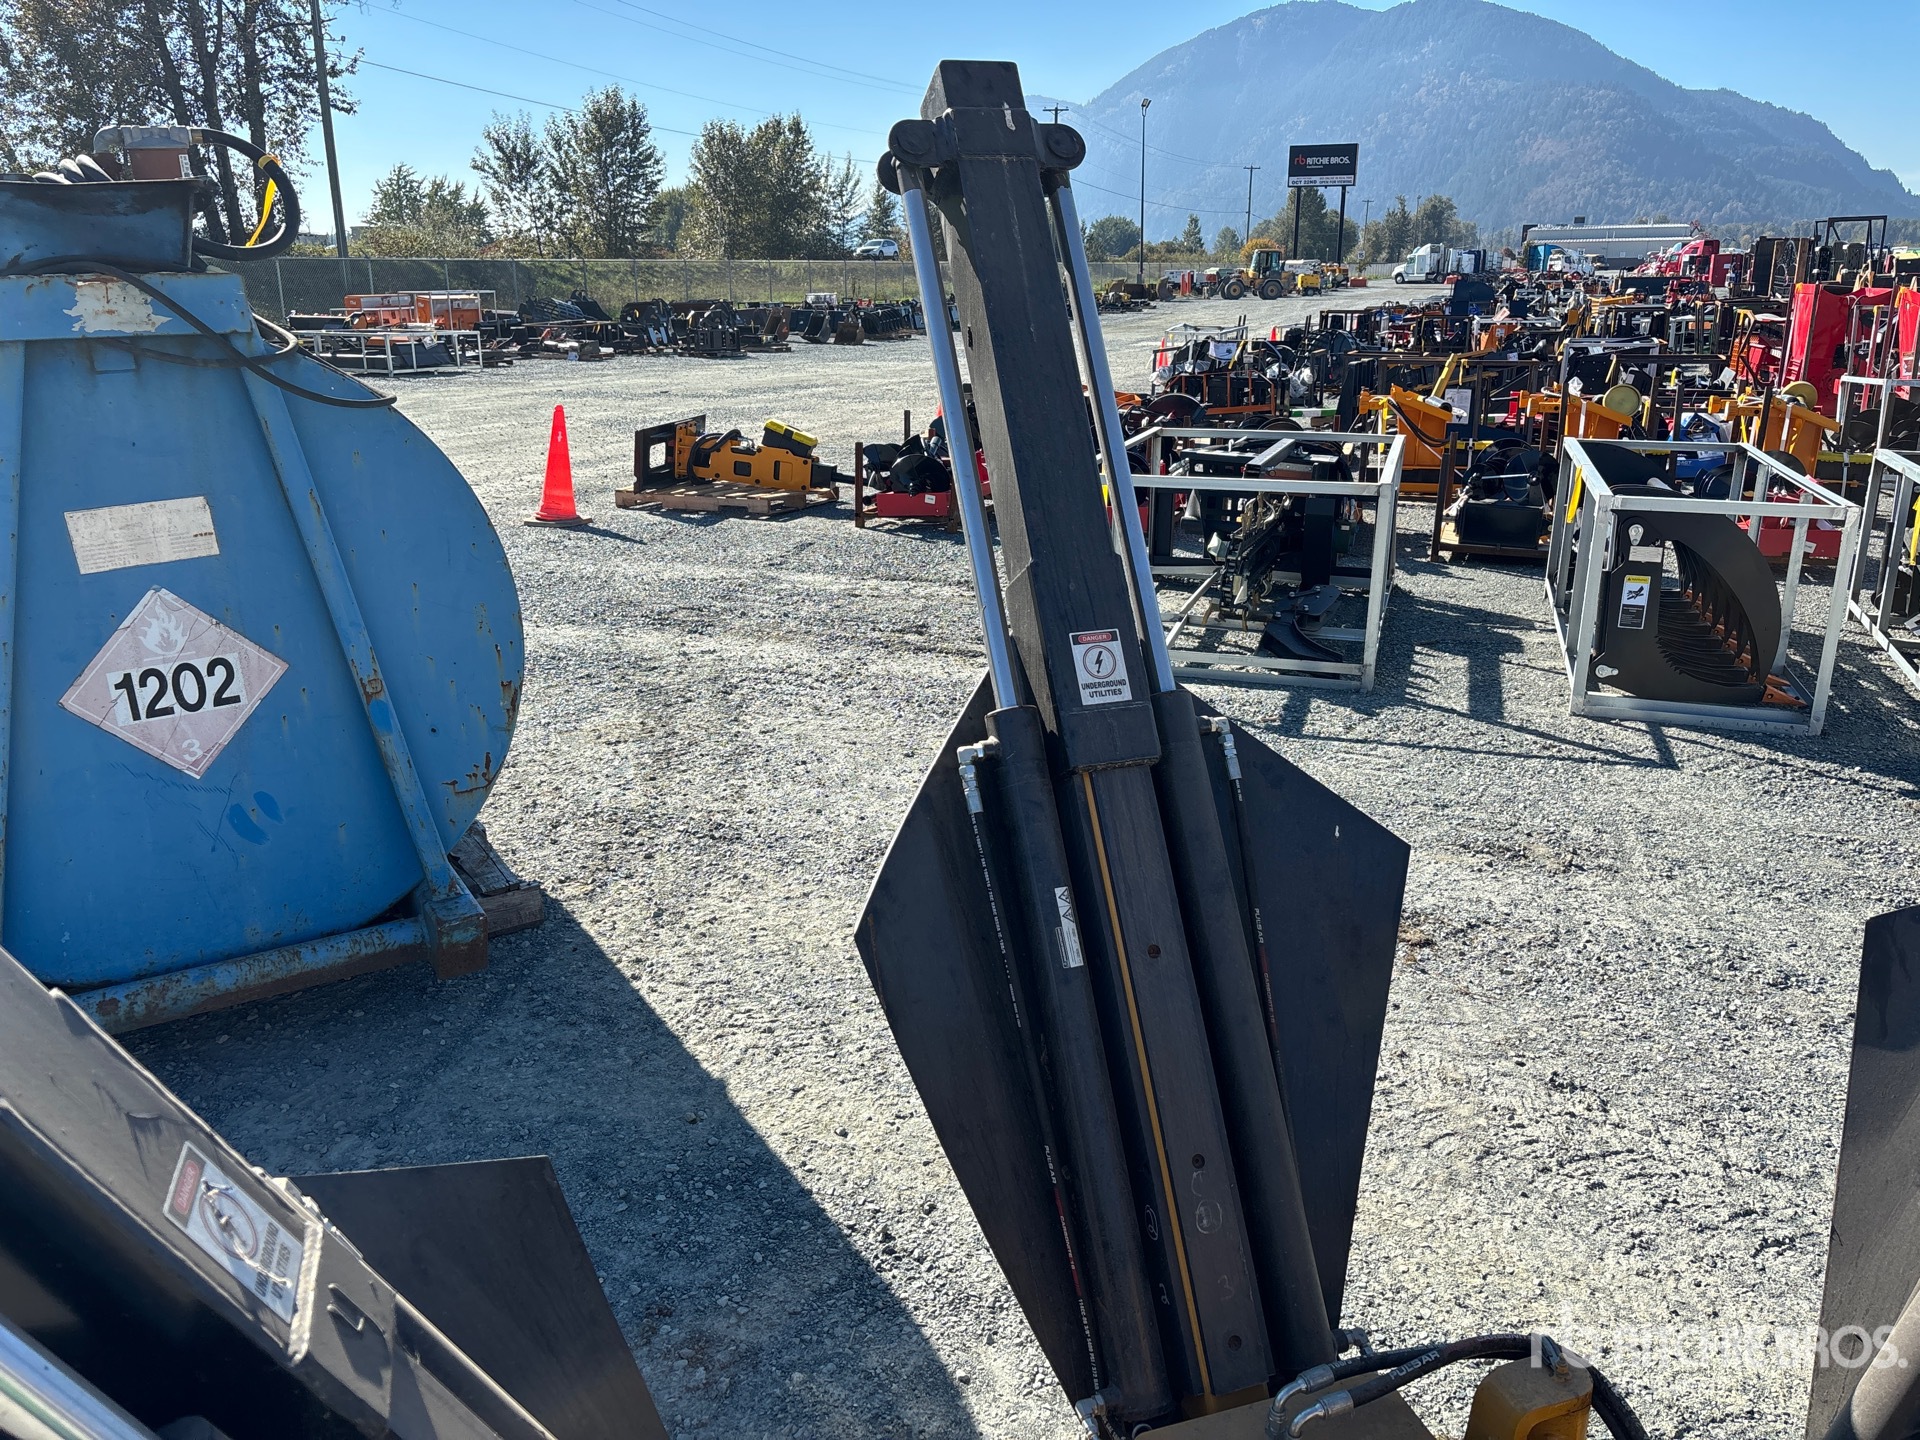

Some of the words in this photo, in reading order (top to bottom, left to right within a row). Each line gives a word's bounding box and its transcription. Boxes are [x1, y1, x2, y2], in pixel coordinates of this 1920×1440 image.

[1307, 157, 1329, 165] RITCHIE
[1082, 634, 1107, 642] DANGER
[114, 657, 241, 722] 1202
[1081, 678, 1127, 690] UNDERGROUND
[1088, 688, 1122, 698] UTILITIES
[182, 738, 203, 762] 3
[1255, 907, 1264, 944] PULSAR
[1044, 1145, 1057, 1184] PULSAR
[177, 1167, 196, 1209] DANGER
[1060, 1215, 1073, 1258] CARBONITE
[254, 1222, 279, 1298] UNDRGROUND
[270, 1241, 290, 1300] UTITIES
[1388, 1350, 1440, 1380] PULSAR
